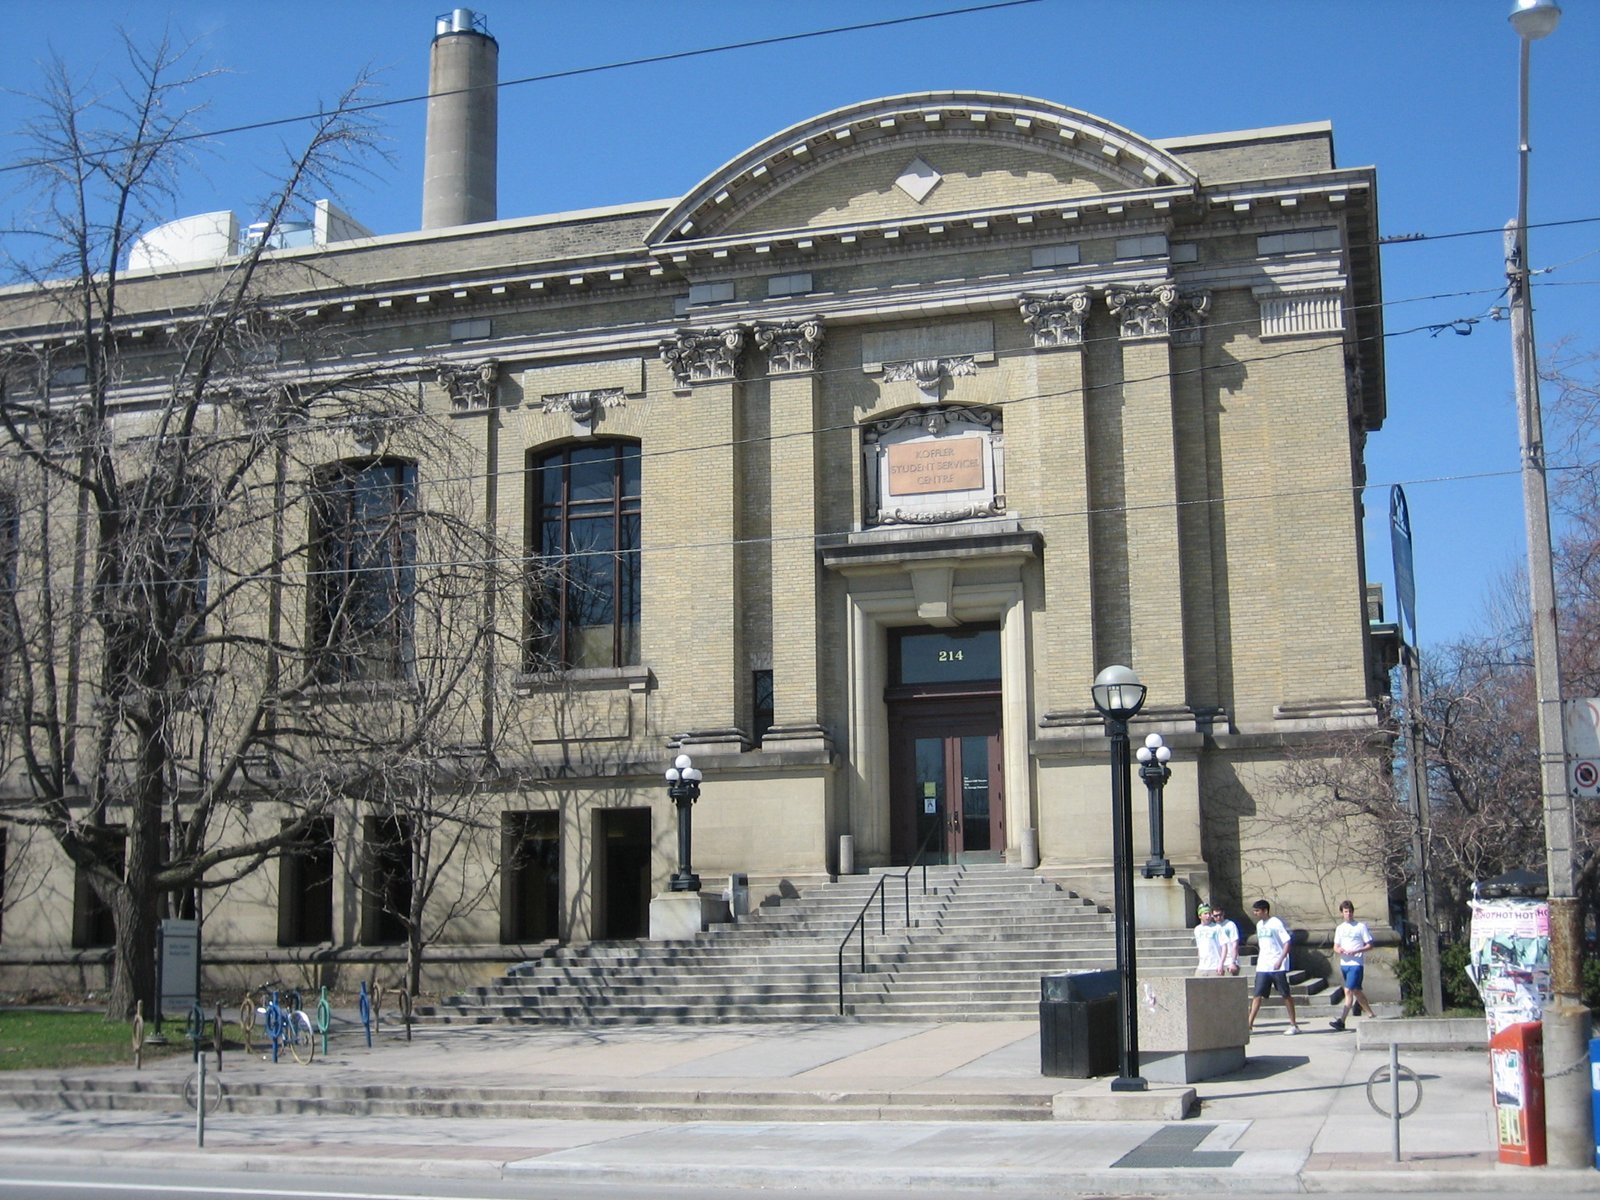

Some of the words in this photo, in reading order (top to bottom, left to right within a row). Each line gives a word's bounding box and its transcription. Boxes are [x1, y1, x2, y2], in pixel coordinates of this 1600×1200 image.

[916, 448, 955, 459] KOFFLER
[891, 463, 935, 474] STUDENT
[917, 475, 954, 485] CENTRE
[938, 650, 964, 661] 214
[1514, 911, 1534, 919] HOT
